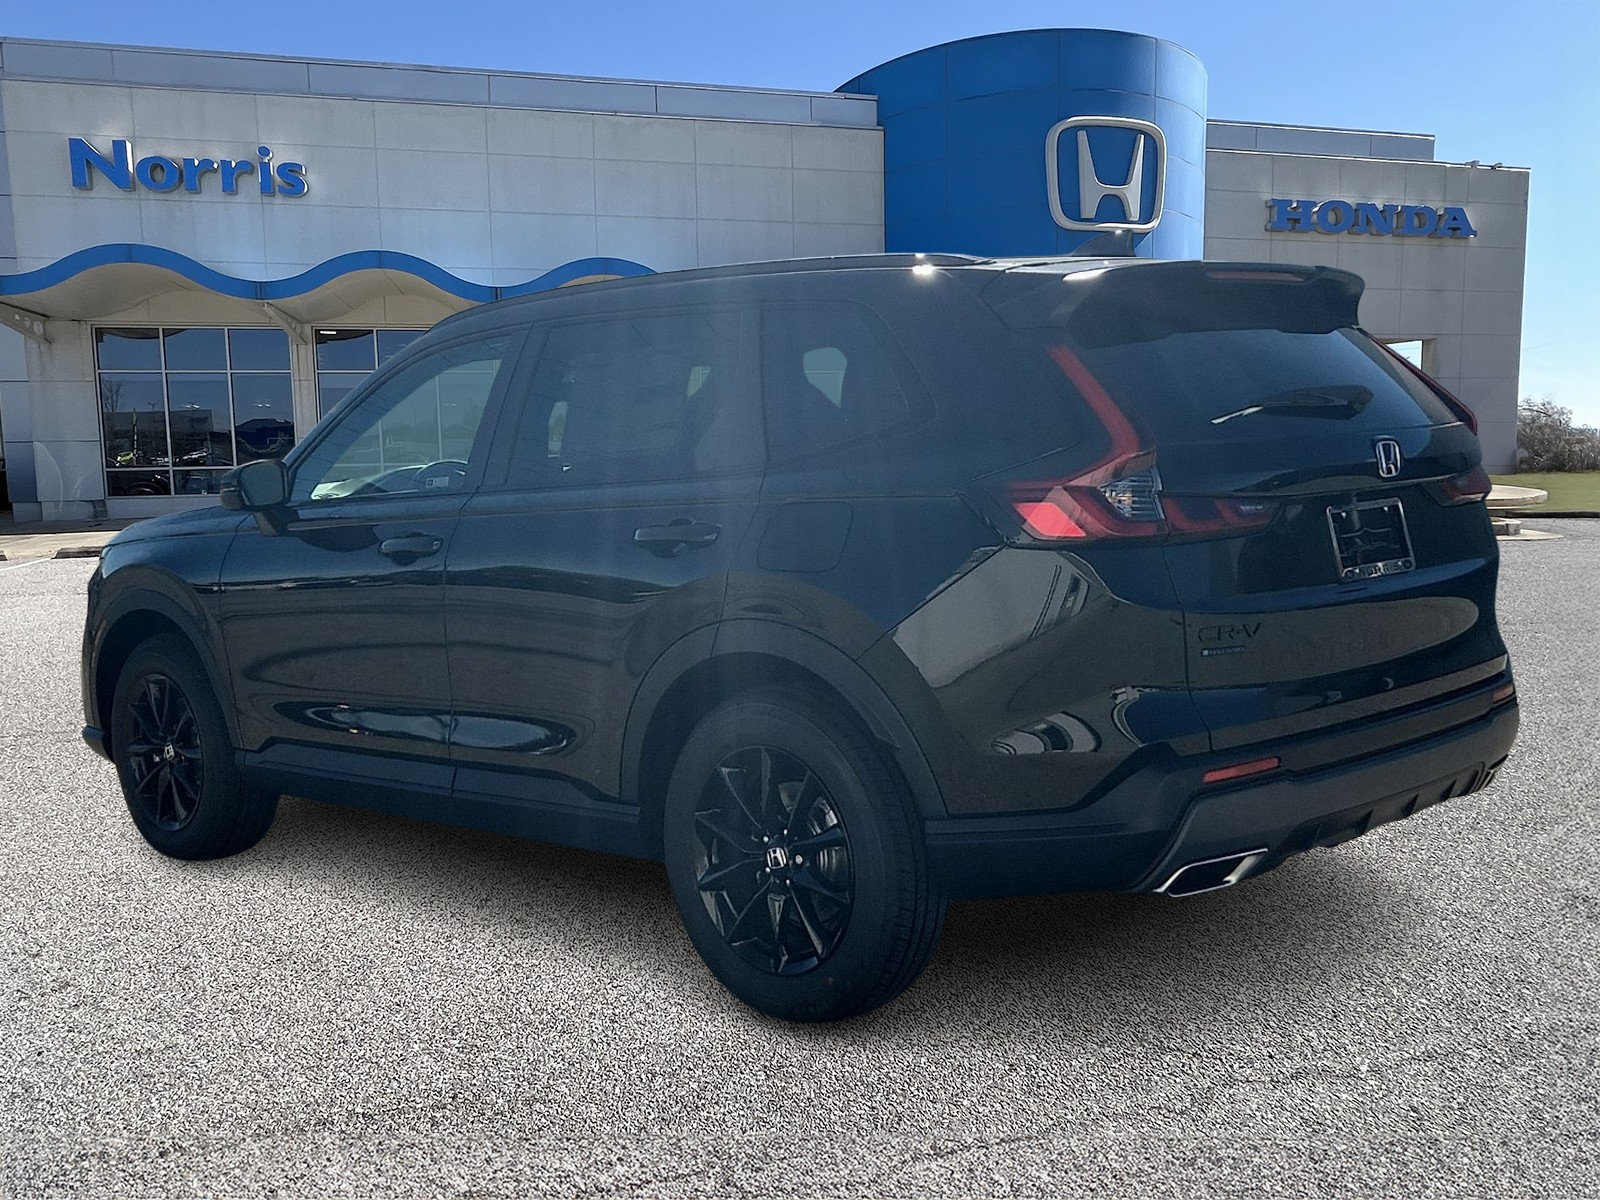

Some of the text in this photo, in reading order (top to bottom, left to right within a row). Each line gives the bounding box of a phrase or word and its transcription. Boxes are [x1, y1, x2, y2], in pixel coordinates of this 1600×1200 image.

[68, 137, 309, 197] Norris
[1266, 198, 1478, 238] HONDA
[1197, 622, 1261, 642] CR-V
